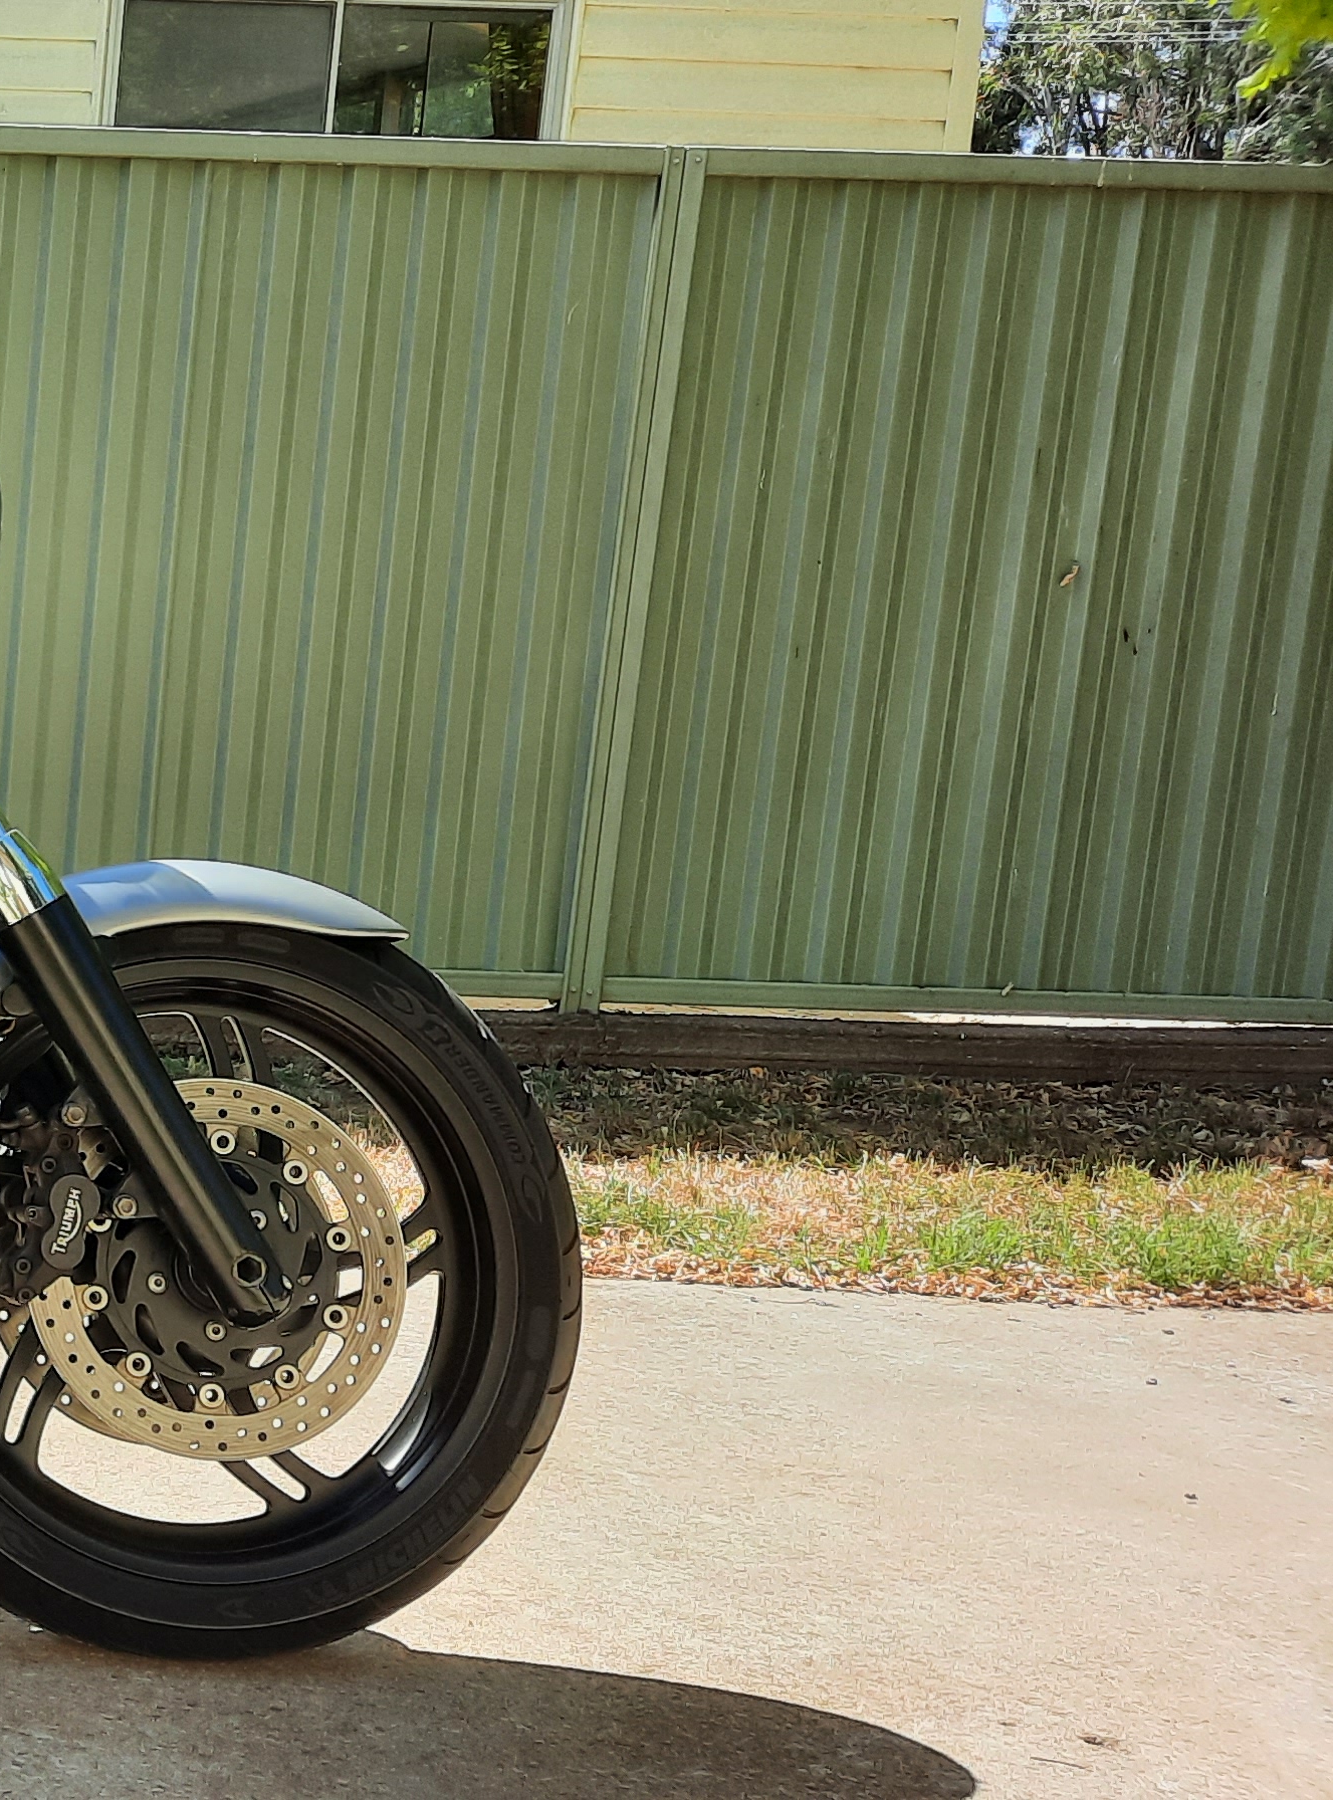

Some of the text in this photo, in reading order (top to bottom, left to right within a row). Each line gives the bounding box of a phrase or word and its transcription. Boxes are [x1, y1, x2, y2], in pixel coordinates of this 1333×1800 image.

[445, 1042, 526, 1164] COMMANDER
[50, 1187, 82, 1255] TRIUMPH
[345, 1474, 484, 1592] MICHELIN
